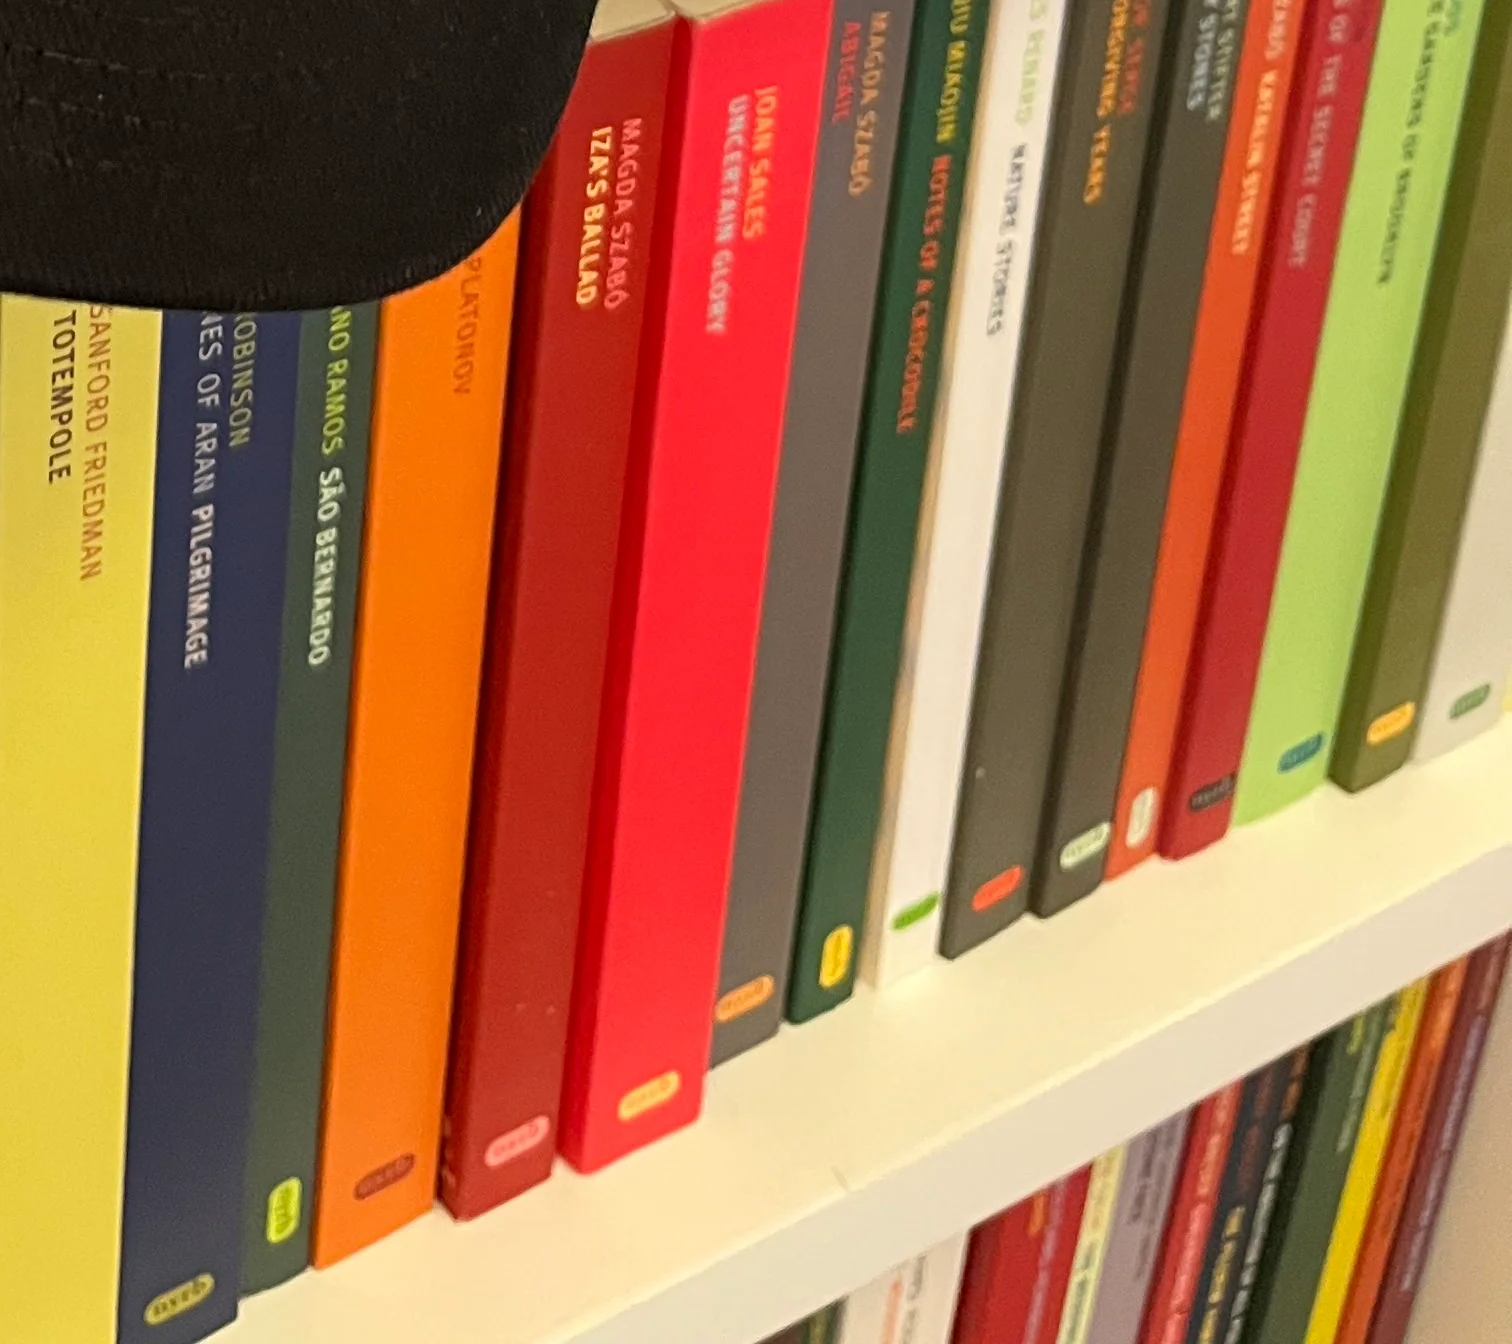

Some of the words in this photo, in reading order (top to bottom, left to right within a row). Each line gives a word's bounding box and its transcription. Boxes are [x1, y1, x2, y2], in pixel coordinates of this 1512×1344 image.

[834, 23, 860, 121] ABIGAIL
[862, 11, 889, 106] MAGDA
[586, 126, 613, 197] IZA'S
[614, 118, 642, 218] MAGDA
[753, 85, 779, 154] JOAN
[717, 95, 748, 243] UNCERTAIN
[742, 158, 769, 241] SALES
[576, 204, 605, 308] BALLAD
[705, 250, 734, 335] GLORY
[48, 310, 76, 485] TOTEMPOLE
[87, 306, 112, 432] SANFORD
[197, 373, 221, 407] OF
[322, 359, 349, 456] RAMOS
[192, 422, 218, 494] ARAN
[318, 467, 344, 522] SÃO
[80, 441, 107, 581] FRIEDMAN
[185, 504, 214, 669] PILGRIMAGE
[308, 527, 338, 666] BERNARDO
